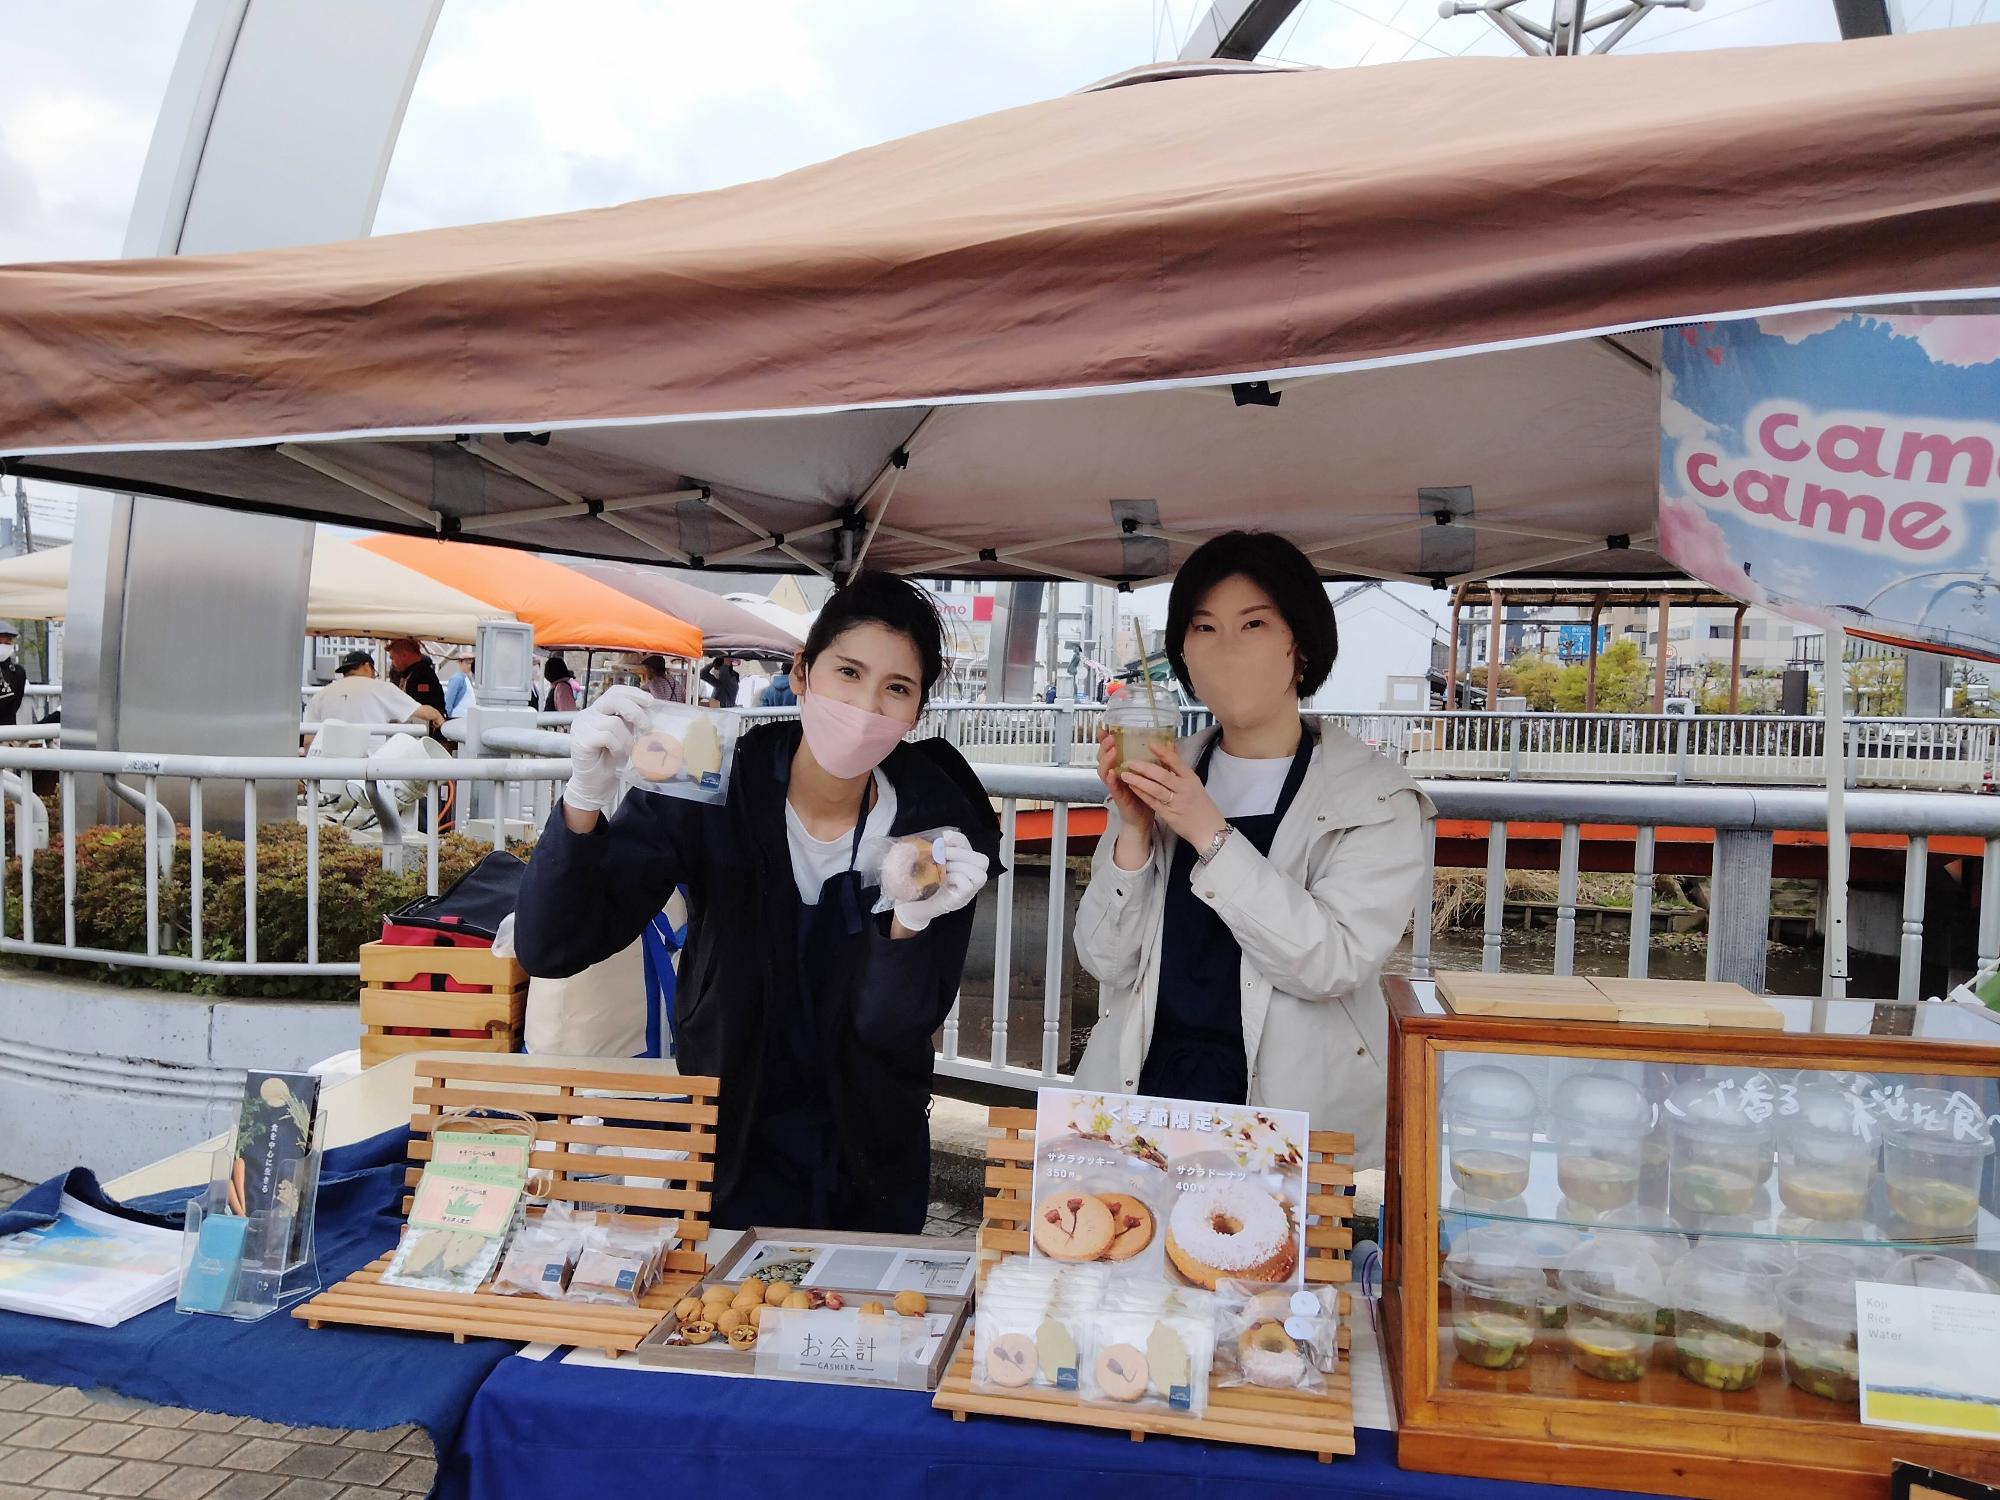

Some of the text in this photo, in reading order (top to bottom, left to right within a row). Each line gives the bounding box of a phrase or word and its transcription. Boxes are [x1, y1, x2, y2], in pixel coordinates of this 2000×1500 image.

[1759, 412, 2000, 488] cam
[1686, 452, 1951, 551] came
[261, 1123, 279, 1194] 食を中心に生きる
[1047, 1152, 1116, 1167] サクラクッキー
[1175, 1164, 1247, 1181] サクラドーナツ
[1865, 1297, 1888, 1312] Koji
[1867, 1312, 1892, 1325] Rice
[1868, 1328, 1903, 1342] Water
[800, 1332, 877, 1363] お会計
[817, 1362, 856, 1372] CASHIER
